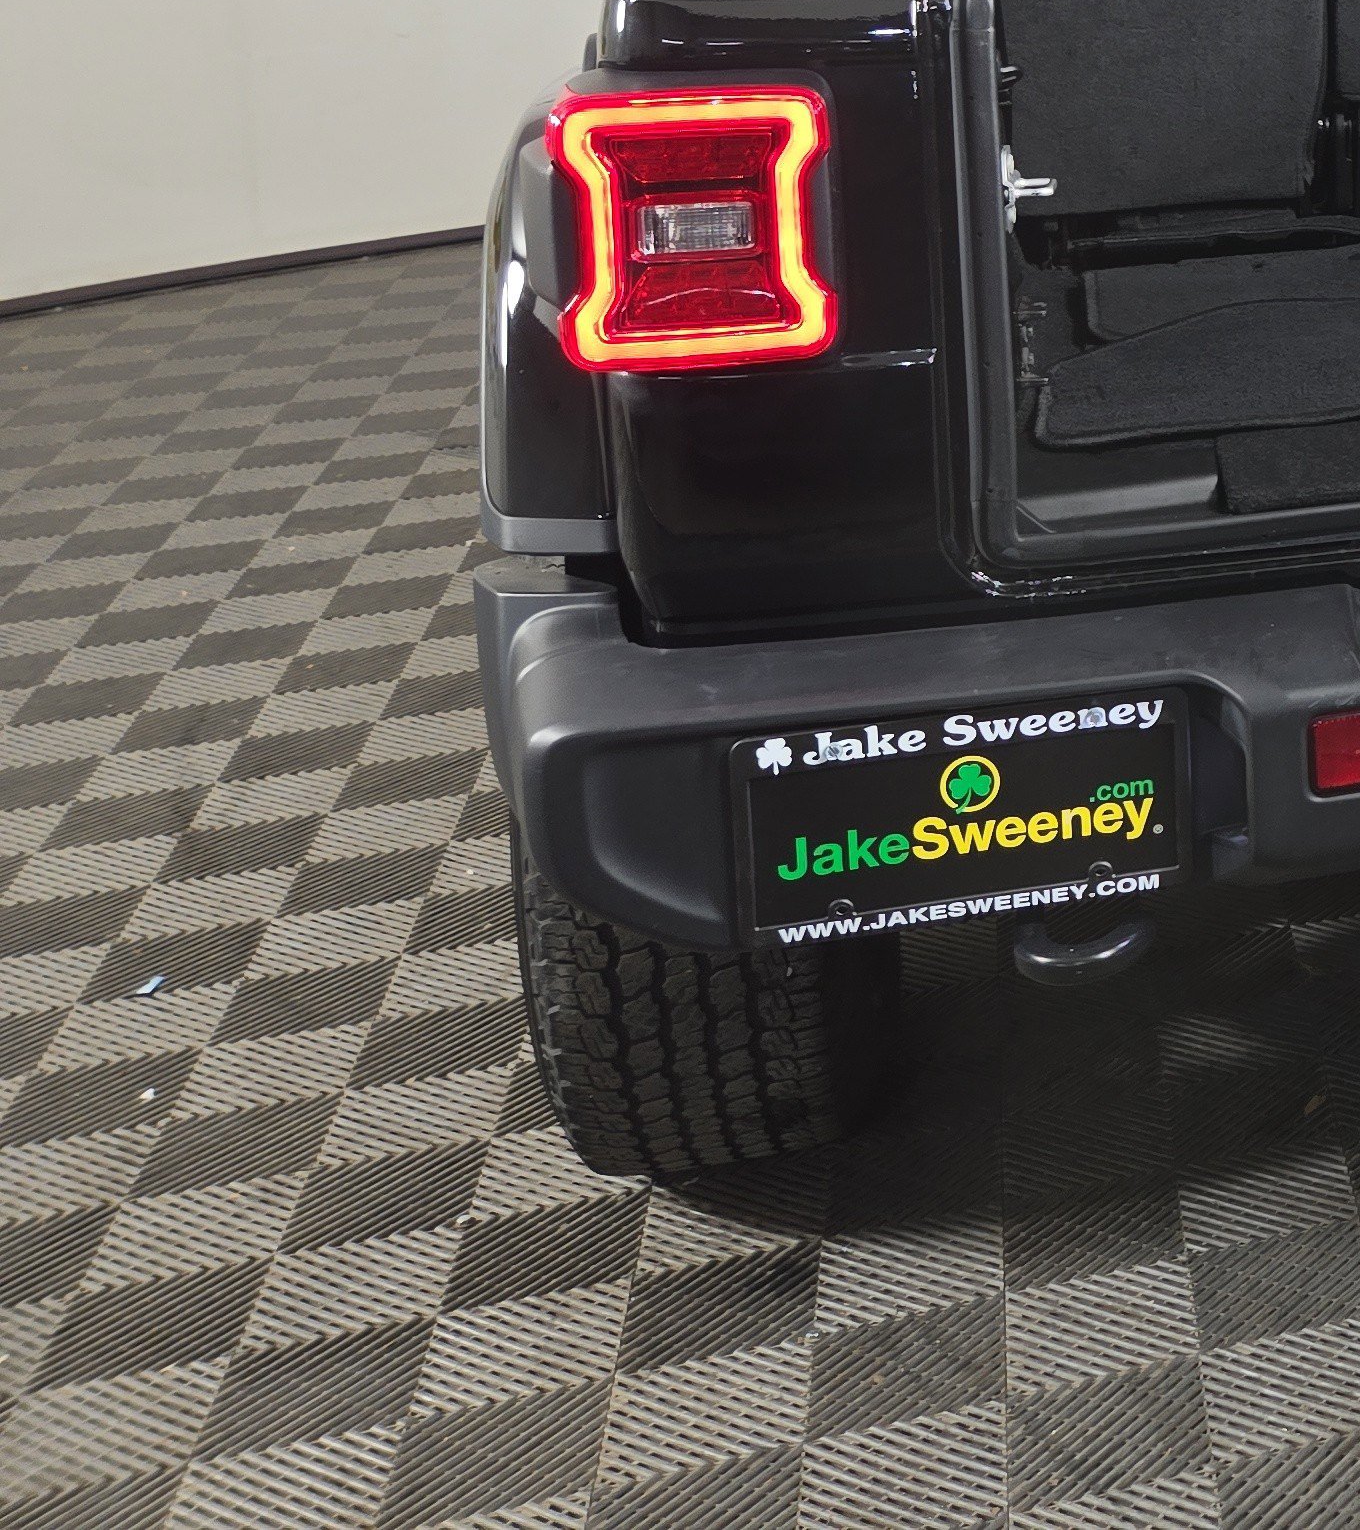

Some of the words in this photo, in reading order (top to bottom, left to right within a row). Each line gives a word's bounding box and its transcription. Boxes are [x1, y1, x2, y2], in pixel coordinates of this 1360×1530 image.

[803, 725, 927, 767] Jake
[943, 699, 1164, 748] Sweeney
[1090, 777, 1155, 803] .com
[777, 797, 1154, 881] JakeSweeney
[778, 874, 1161, 944] WWW.JAKESWEENEY.COM
